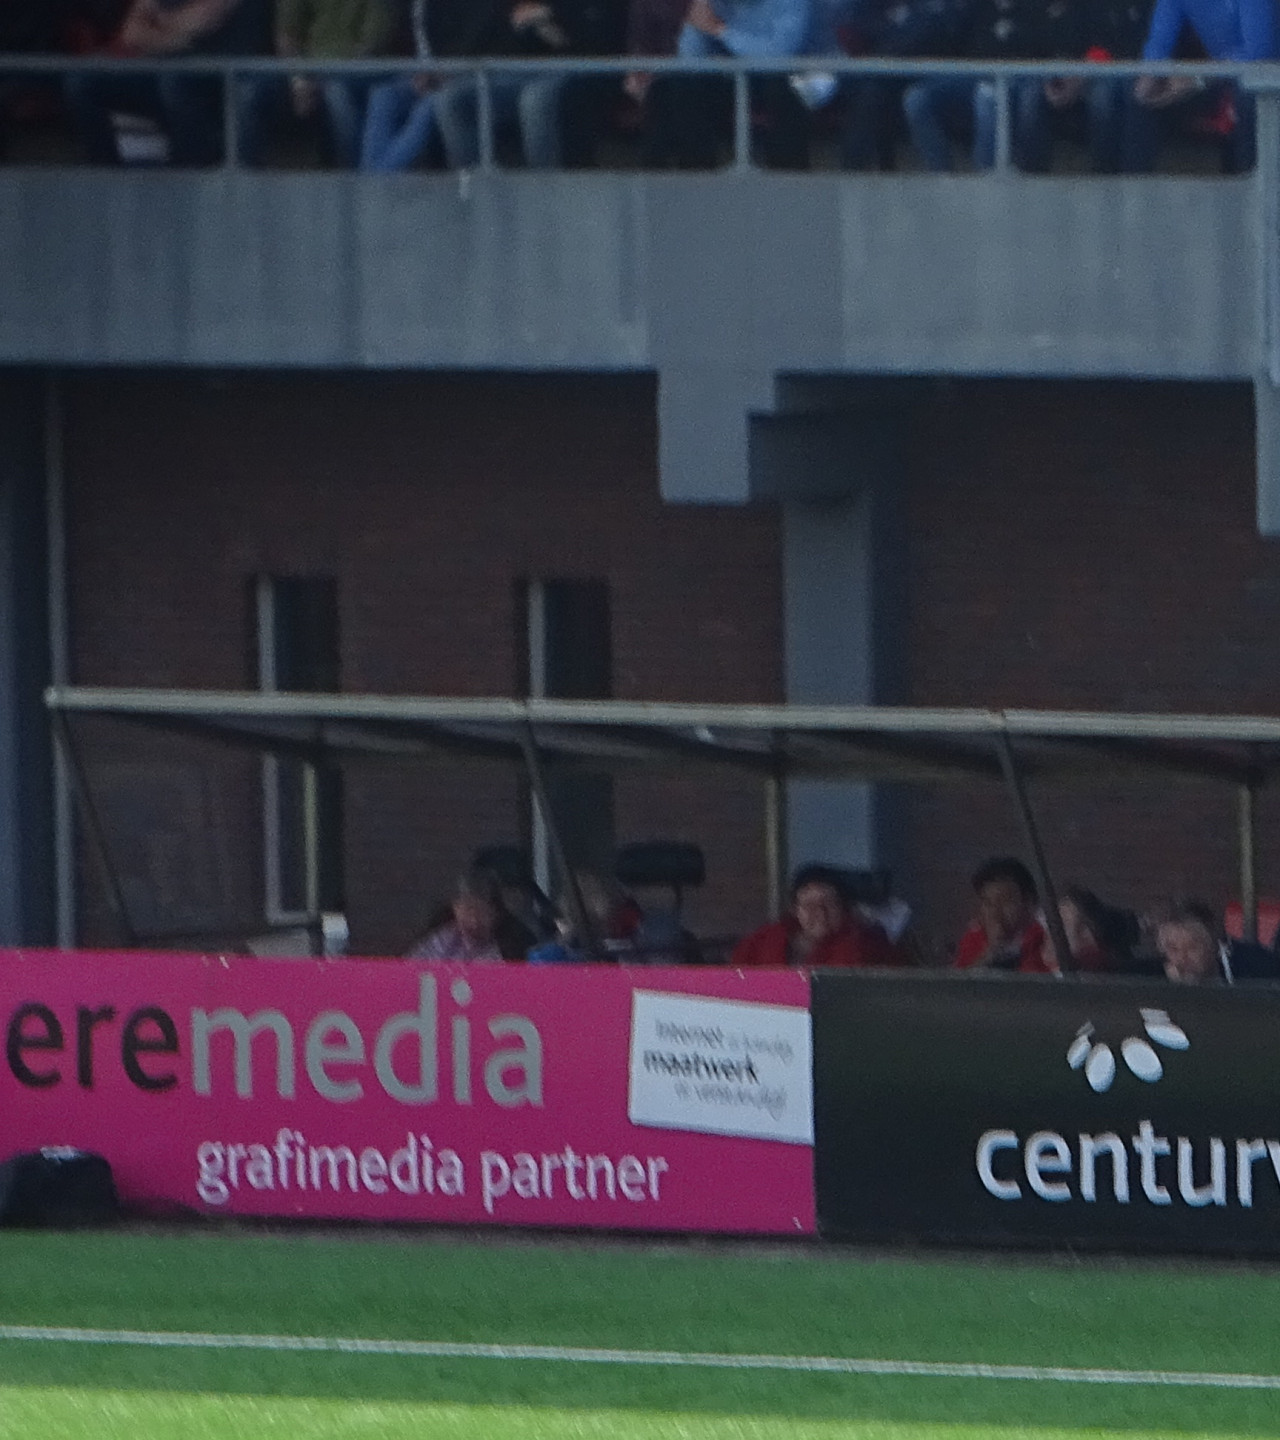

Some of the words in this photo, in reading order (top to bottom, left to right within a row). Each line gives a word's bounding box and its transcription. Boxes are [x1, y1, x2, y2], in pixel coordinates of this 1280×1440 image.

[5, 972, 543, 1109] eremedia
[196, 1128, 466, 1205] grafimedia
[480, 1144, 669, 1213] partner
